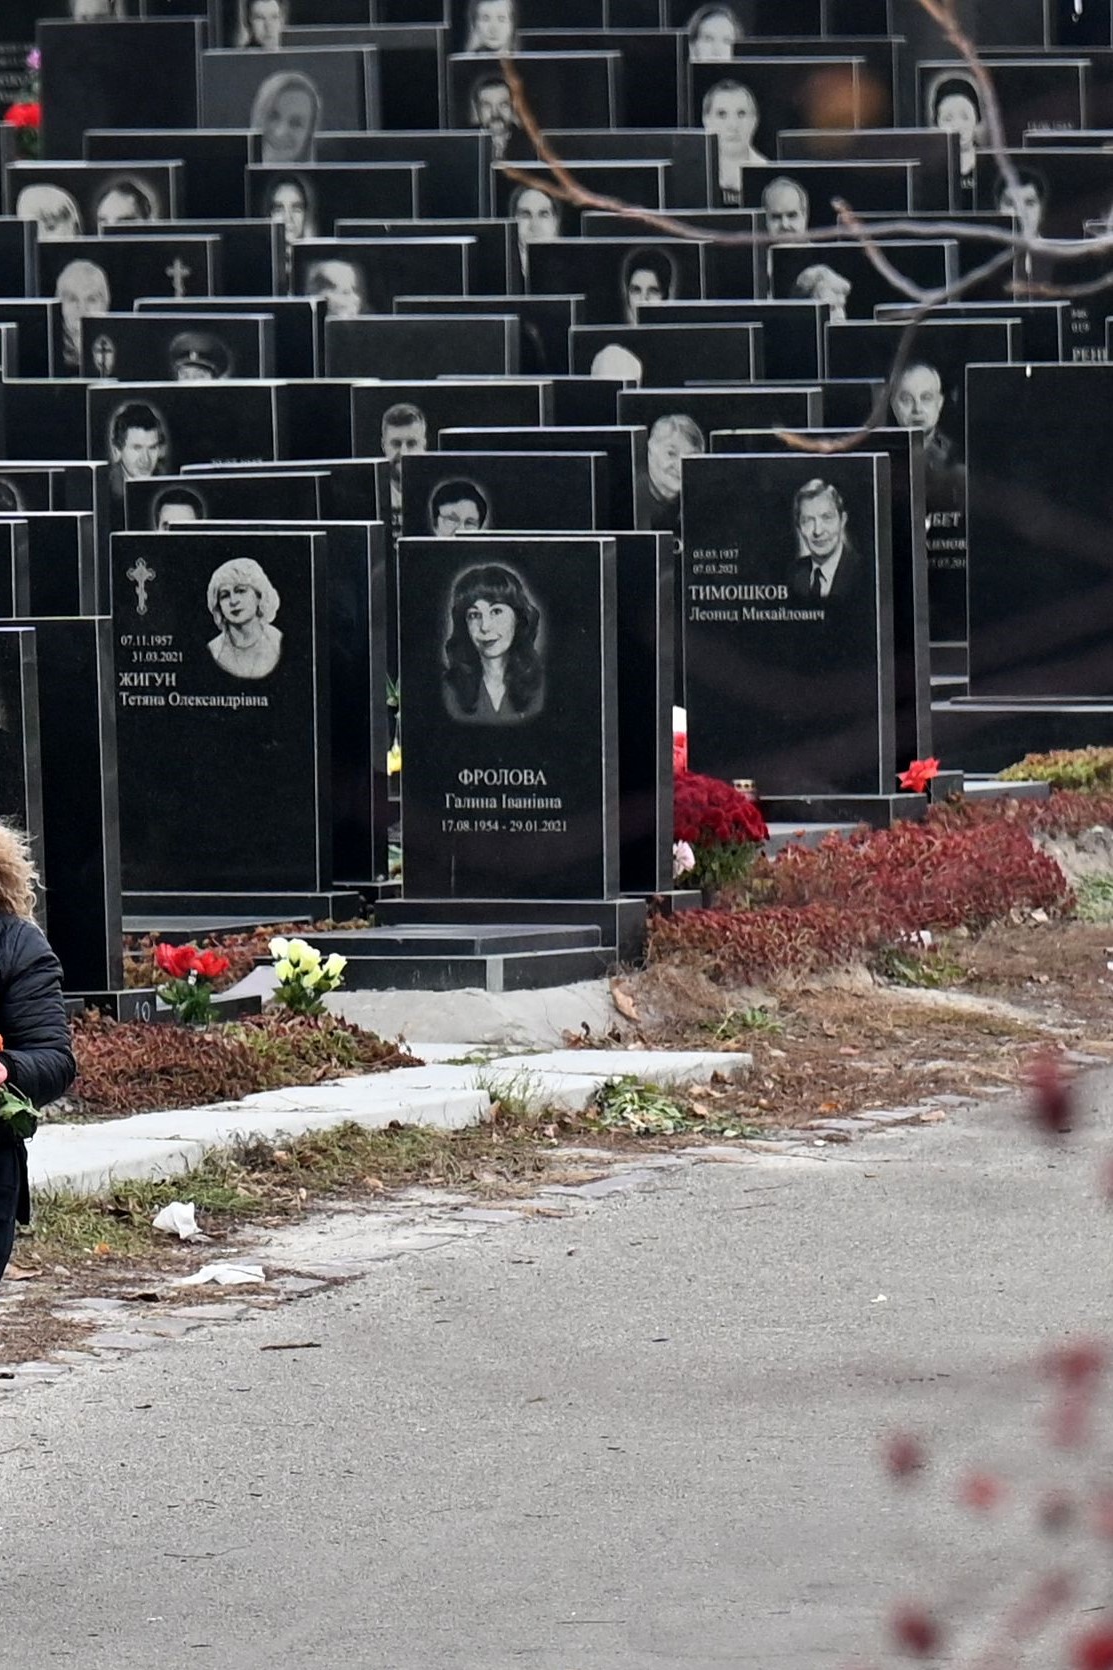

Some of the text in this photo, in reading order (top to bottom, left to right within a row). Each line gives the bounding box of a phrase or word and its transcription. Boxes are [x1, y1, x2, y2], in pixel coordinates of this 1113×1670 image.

[688, 585, 788, 601] ТИМОШКОВ
[742, 606, 825, 621] Михайлович
[120, 634, 173, 647] 07.11.1957
[131, 650, 183, 663] 31.03.2021
[119, 672, 176, 687] ЖИГУН
[119, 692, 269, 710] Тетяна Олександрівна
[458, 769, 547, 786] ФРОЛОВА
[445, 793, 562, 809] Галина Іванівна
[441, 820, 499, 832] 17.08.1954
[509, 820, 567, 832] 29.01.2021
